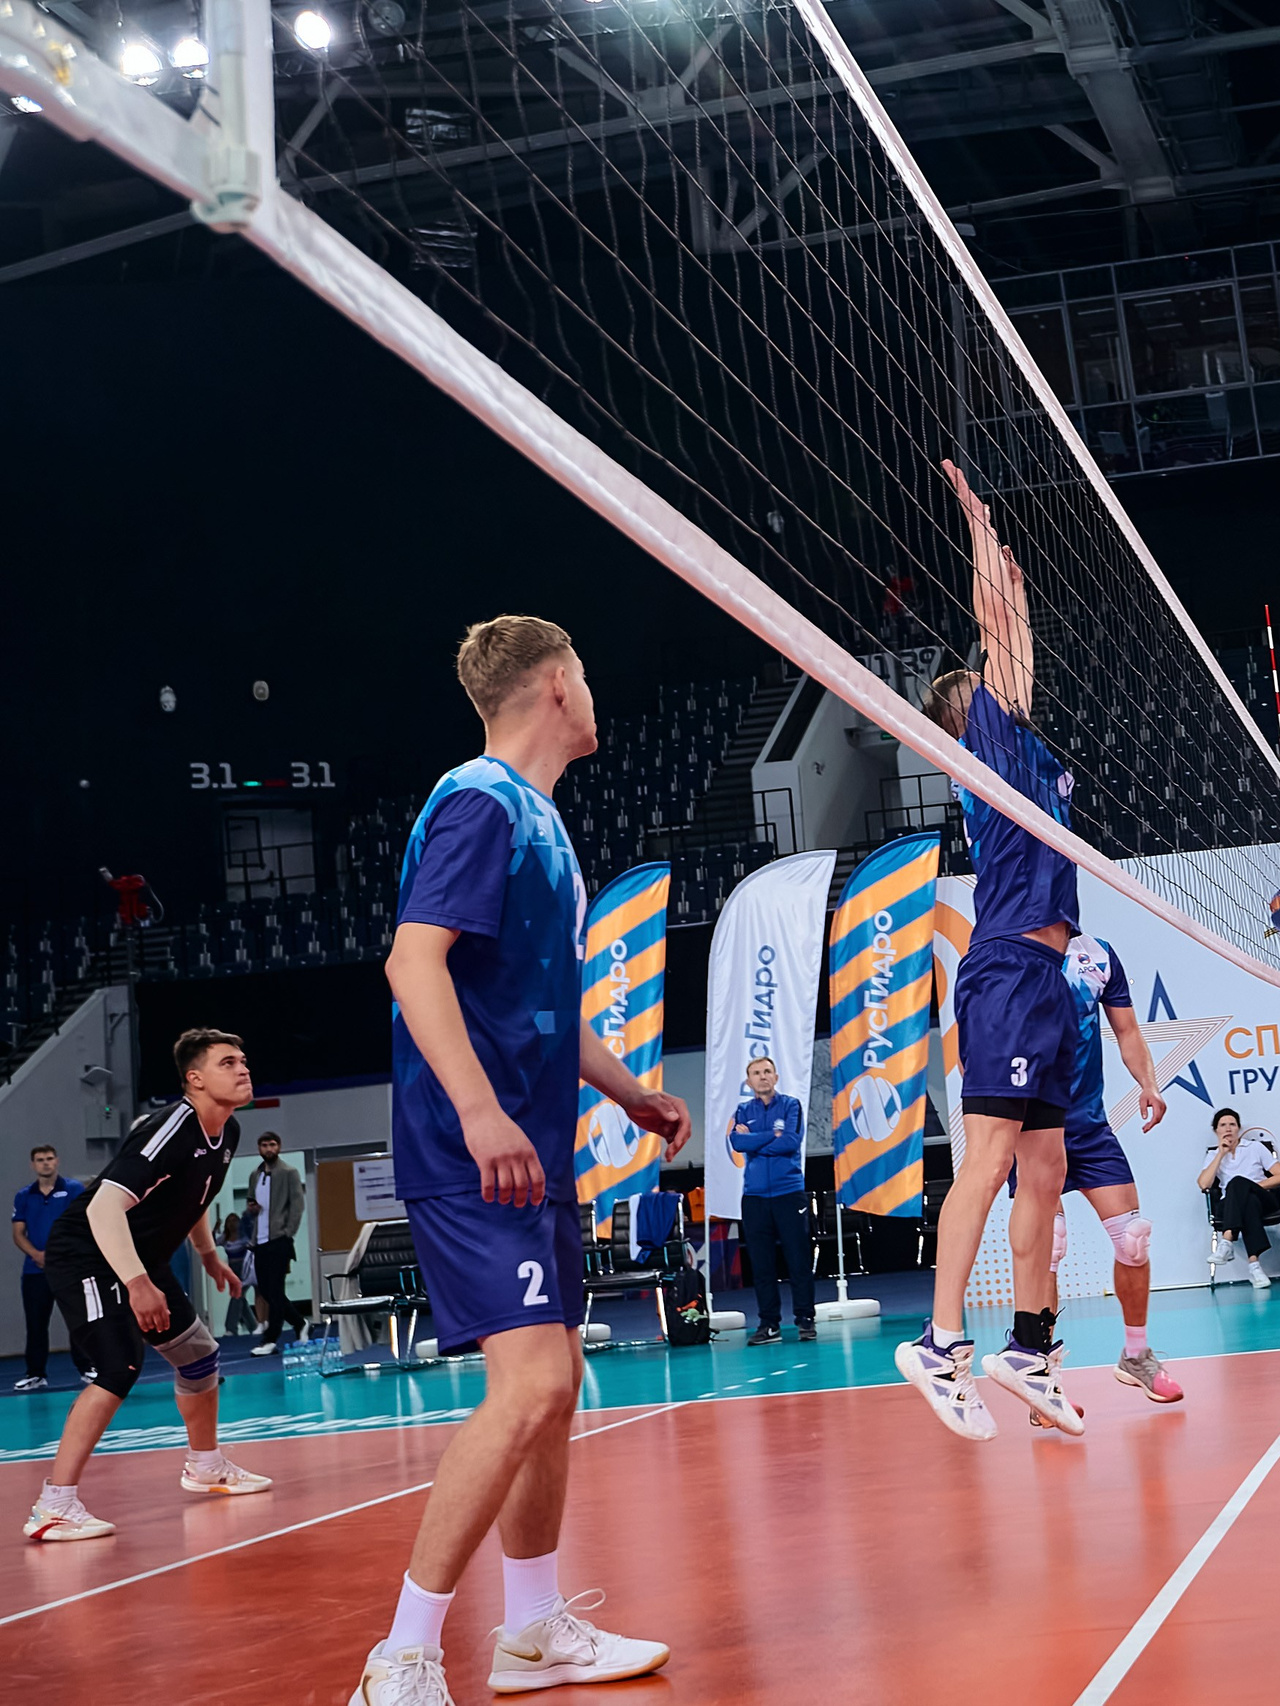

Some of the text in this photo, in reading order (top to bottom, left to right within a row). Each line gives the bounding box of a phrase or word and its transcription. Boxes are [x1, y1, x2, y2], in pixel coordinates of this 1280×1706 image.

[190, 763, 237, 789] 3.1
[291, 761, 336, 788] 3.1
[603, 938, 630, 1060] сГидро
[863, 910, 897, 1070] РусГидро
[1011, 1057, 1028, 1087] 3
[200, 1175, 212, 1205] 1
[110, 1282, 121, 1304] 1
[517, 1260, 549, 1306] 2
